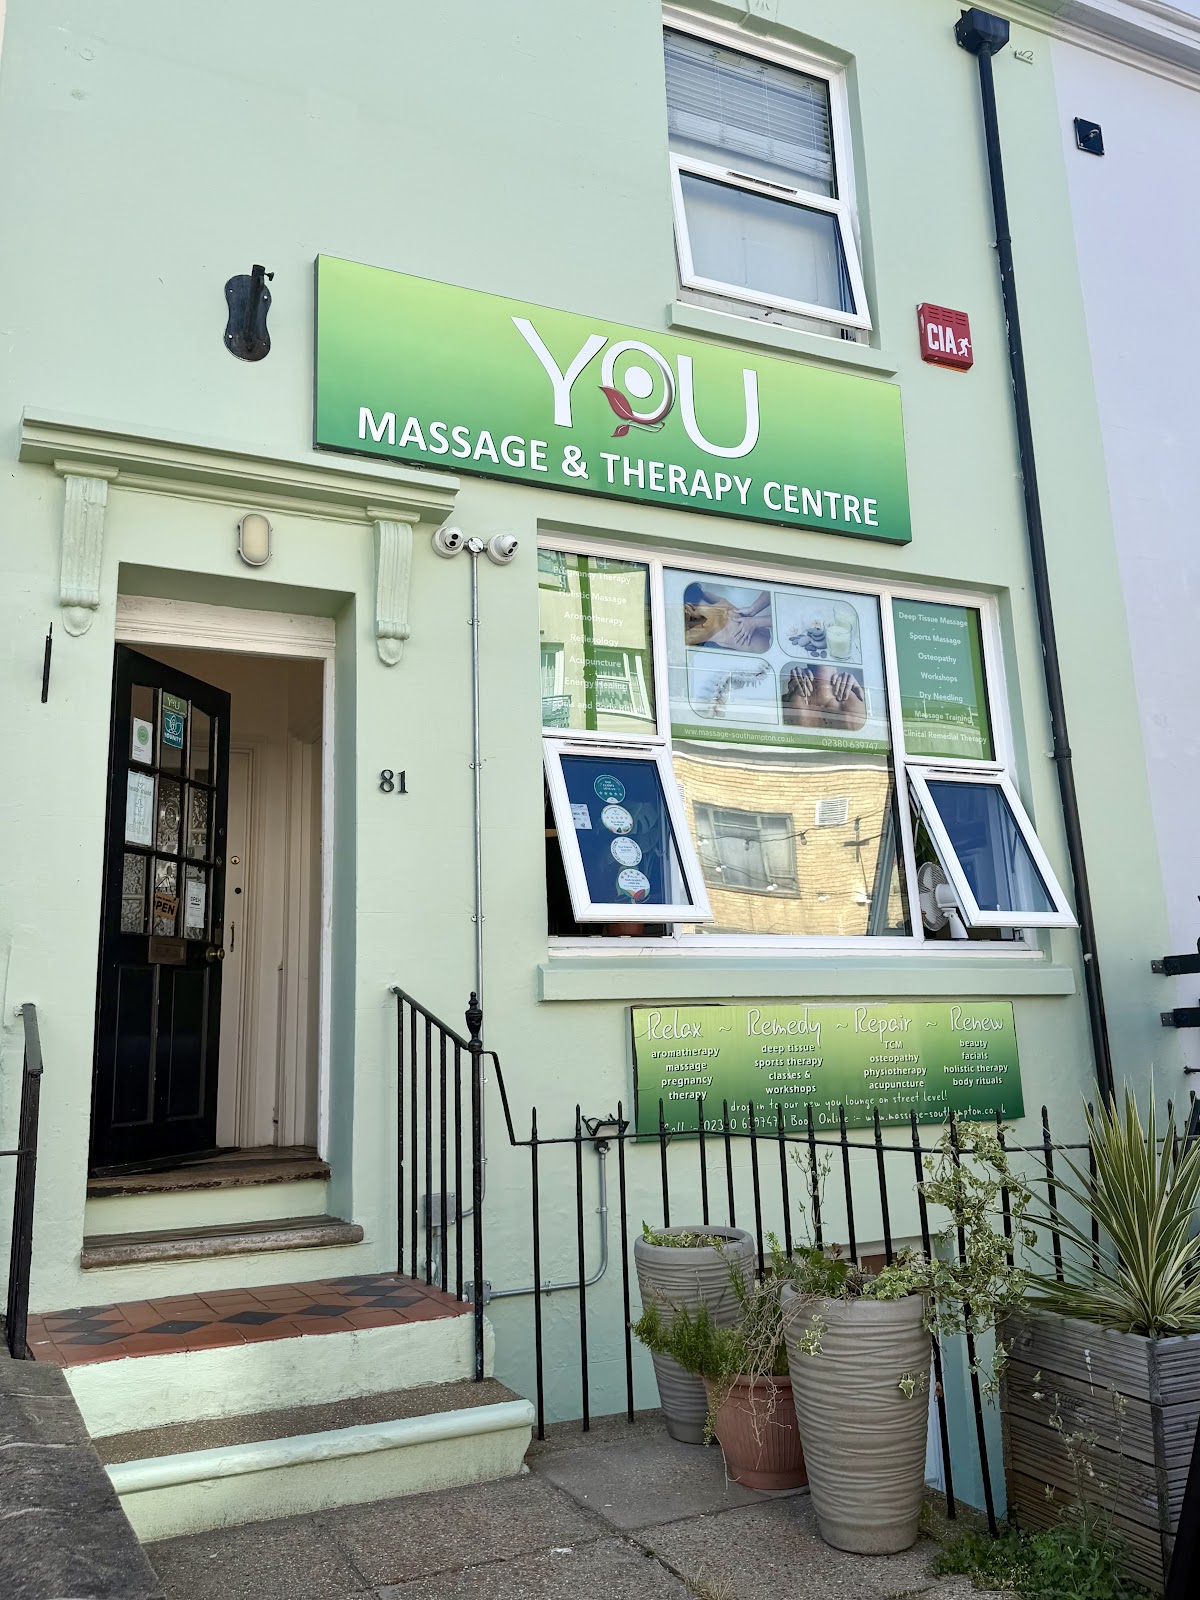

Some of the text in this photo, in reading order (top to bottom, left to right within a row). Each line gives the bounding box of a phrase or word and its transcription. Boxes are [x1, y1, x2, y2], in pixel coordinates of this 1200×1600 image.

[927, 322, 957, 355] CIA
[510, 316, 760, 459] YOU
[357, 407, 879, 528] MASSAGE & THERAPY CENTRE
[598, 572, 631, 585] Therapy
[591, 593, 627, 606] Massage
[899, 612, 968, 627] Deep Tissue Massage
[570, 633, 619, 648] Reflexology
[909, 632, 961, 646] Sports Massage
[569, 655, 621, 668] Acupuncture
[918, 652, 957, 665] Osteopathy
[564, 677, 594, 689] Energy
[920, 671, 958, 683] Workshops
[919, 691, 963, 704] Dry Needling
[914, 710, 972, 724] Massage Training
[904, 729, 987, 745] Clinical Remedial Therapy
[821, 738, 848, 748] 02380
[849, 740, 879, 750] 639747
[379, 769, 408, 794] 81
[154, 900, 176, 915] PEN
[648, 1009, 703, 1041] Relax
[747, 1008, 822, 1048] Remedy
[854, 1006, 912, 1042] Repair
[950, 1005, 1004, 1032] Renew
[761, 1043, 816, 1055] deep tissue
[883, 1040, 903, 1049] TCM
[959, 1039, 988, 1050] beauty
[651, 1047, 720, 1059] aromatherapy
[869, 1053, 919, 1065] osteopathy
[962, 1051, 989, 1061] facials
[665, 1062, 708, 1073] massage
[754, 1056, 824, 1069] sports therapy
[943, 1063, 1008, 1074] holistic therapy
[768, 1070, 812, 1081] classes &
[863, 1067, 927, 1079] physiotherapy
[661, 1075, 714, 1088] pregnancy
[869, 1079, 925, 1091] acupuncture
[952, 1076, 1003, 1088] body rituals
[668, 1090, 708, 1101] therapy
[765, 1084, 817, 1096] workshops
[756, 1103, 765, 1111] in
[784, 1101, 799, 1110] our
[825, 1099, 841, 1112] you
[845, 1095, 875, 1111] lounge
[893, 1091, 919, 1103] street
[923, 1090, 948, 1102] level!
[703, 1118, 737, 1132] 0230
[741, 1116, 778, 1130] 69747
[790, 1114, 815, 1126] Boo
[818, 1112, 849, 1125] Onlie
